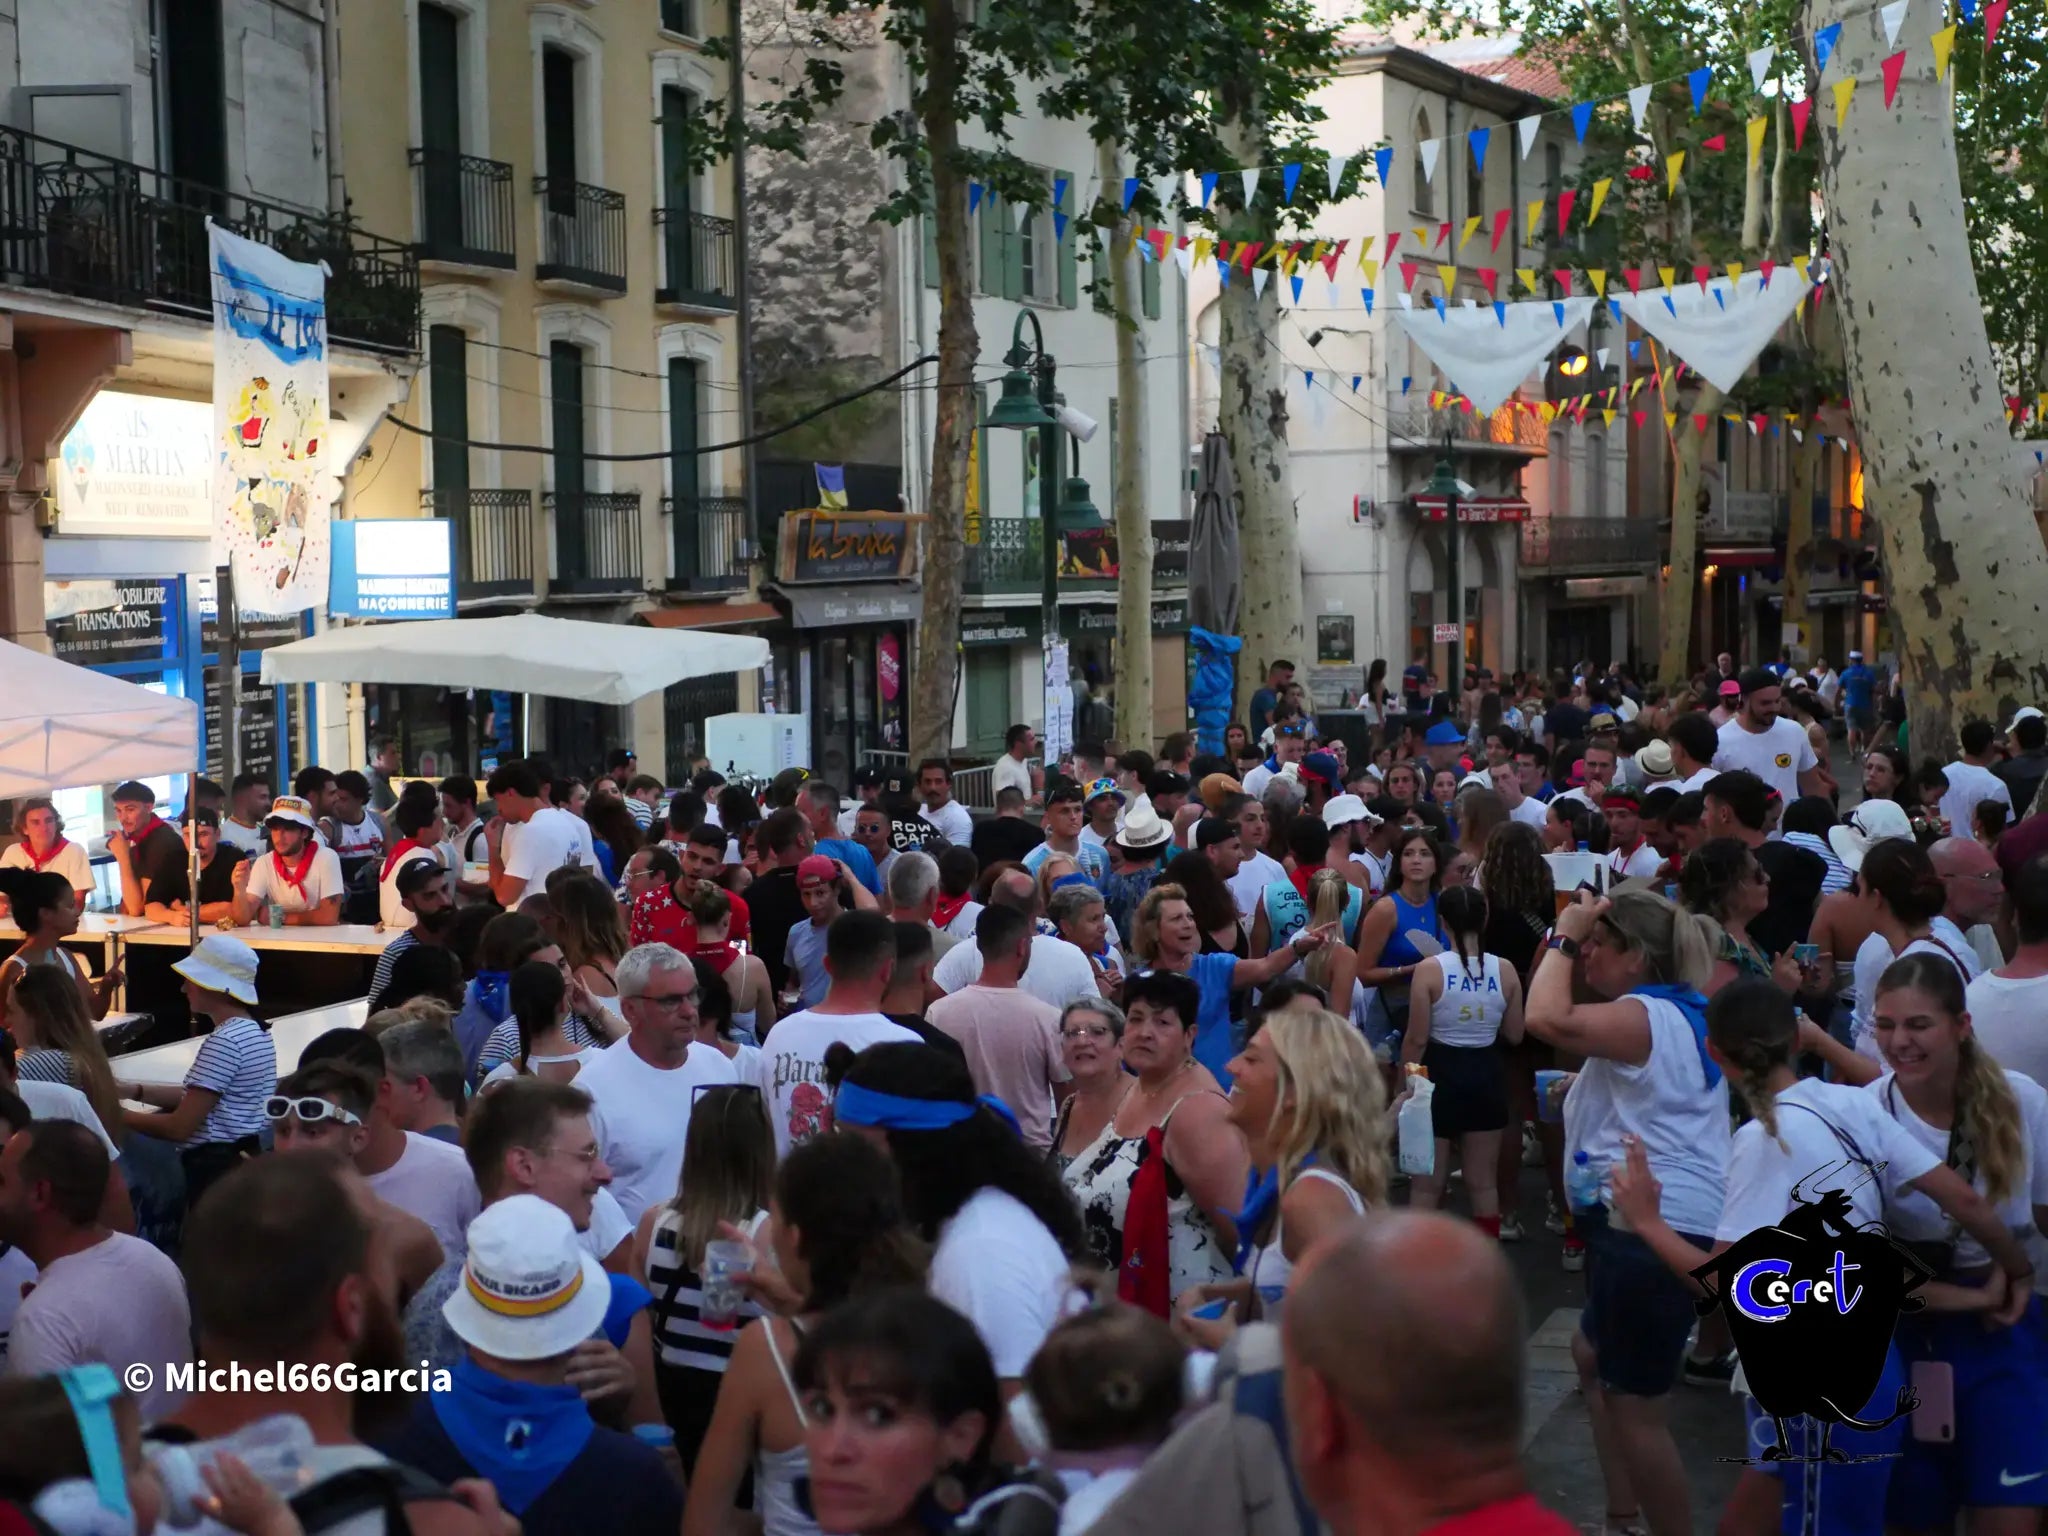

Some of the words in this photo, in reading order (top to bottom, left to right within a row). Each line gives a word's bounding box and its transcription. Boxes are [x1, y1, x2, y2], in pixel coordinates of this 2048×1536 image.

[105, 443, 186, 477] MARTIN
[358, 597, 449, 613] MAÇONNERIE
[75, 610, 151, 632] TRANSACTIONS
[998, 624, 1028, 639] MÉDICAL
[1447, 974, 1498, 992] FAFA
[1458, 1005, 1485, 1023] 51
[773, 1051, 827, 1100] Para
[503, 1279, 562, 1298] RICARD
